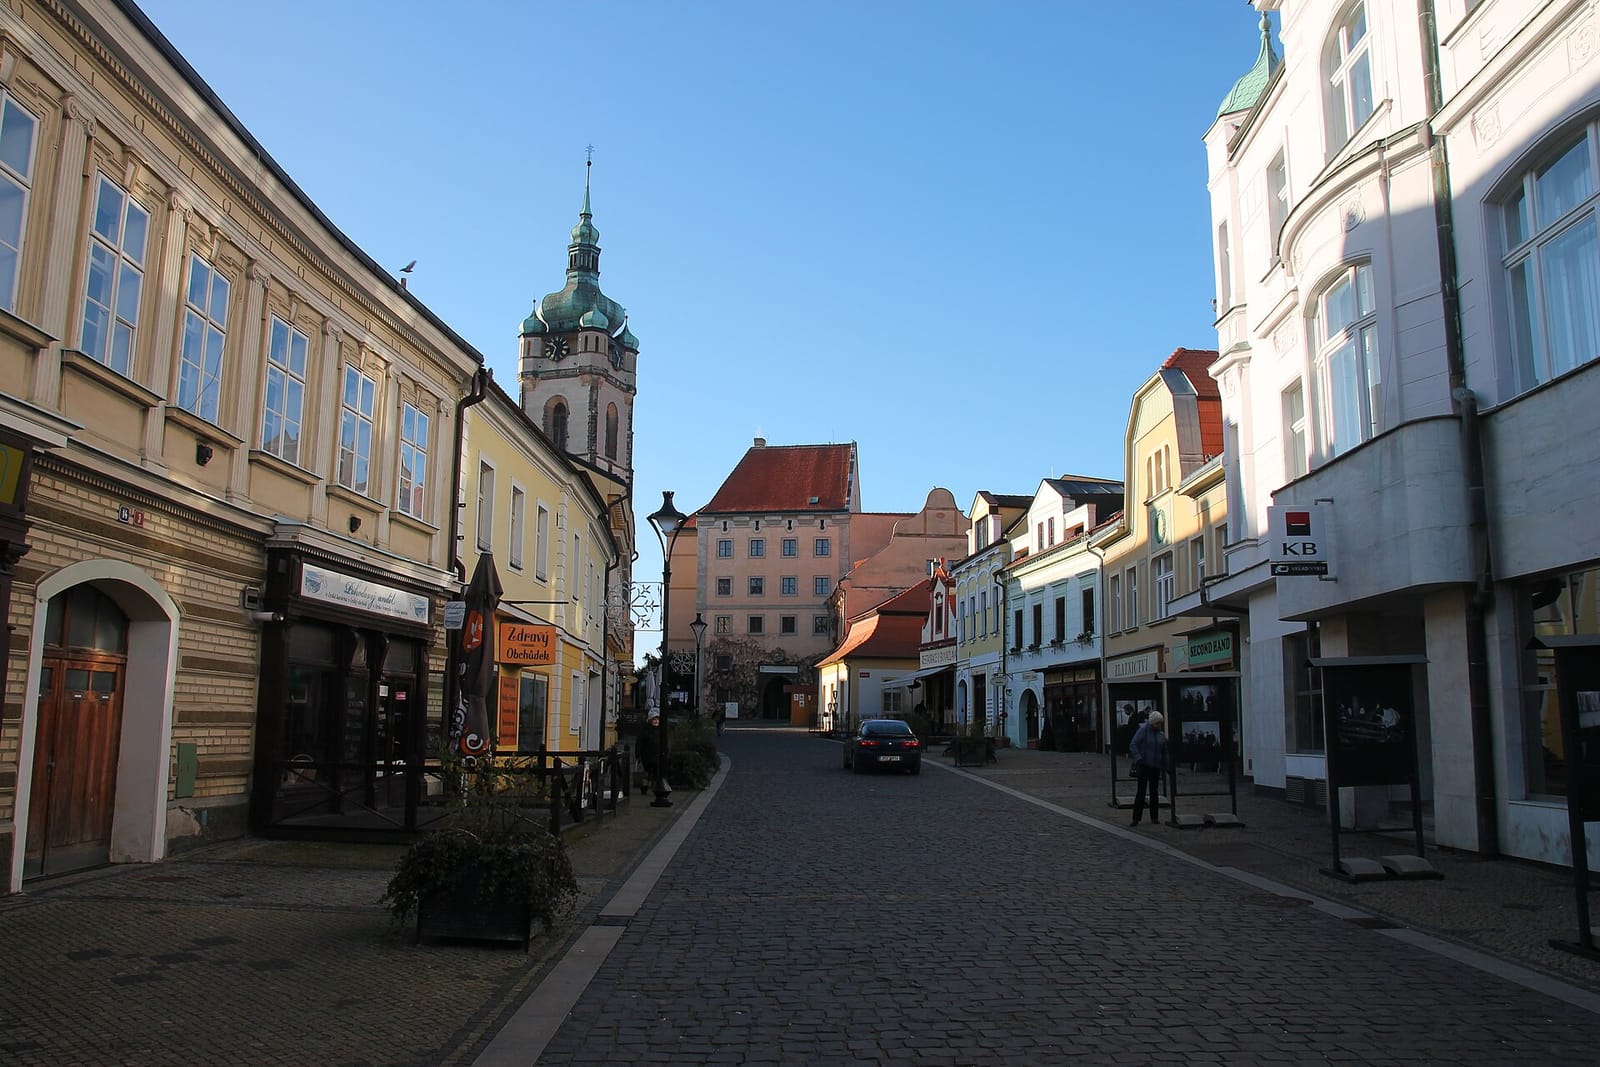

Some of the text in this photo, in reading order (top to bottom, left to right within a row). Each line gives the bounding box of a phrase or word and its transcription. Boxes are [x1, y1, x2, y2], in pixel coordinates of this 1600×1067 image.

[1282, 542, 1318, 556] KB
[507, 626, 549, 647] Zdravý
[506, 647, 550, 661] Obchůdek
[1190, 637, 1231, 658] SECOND HAND
